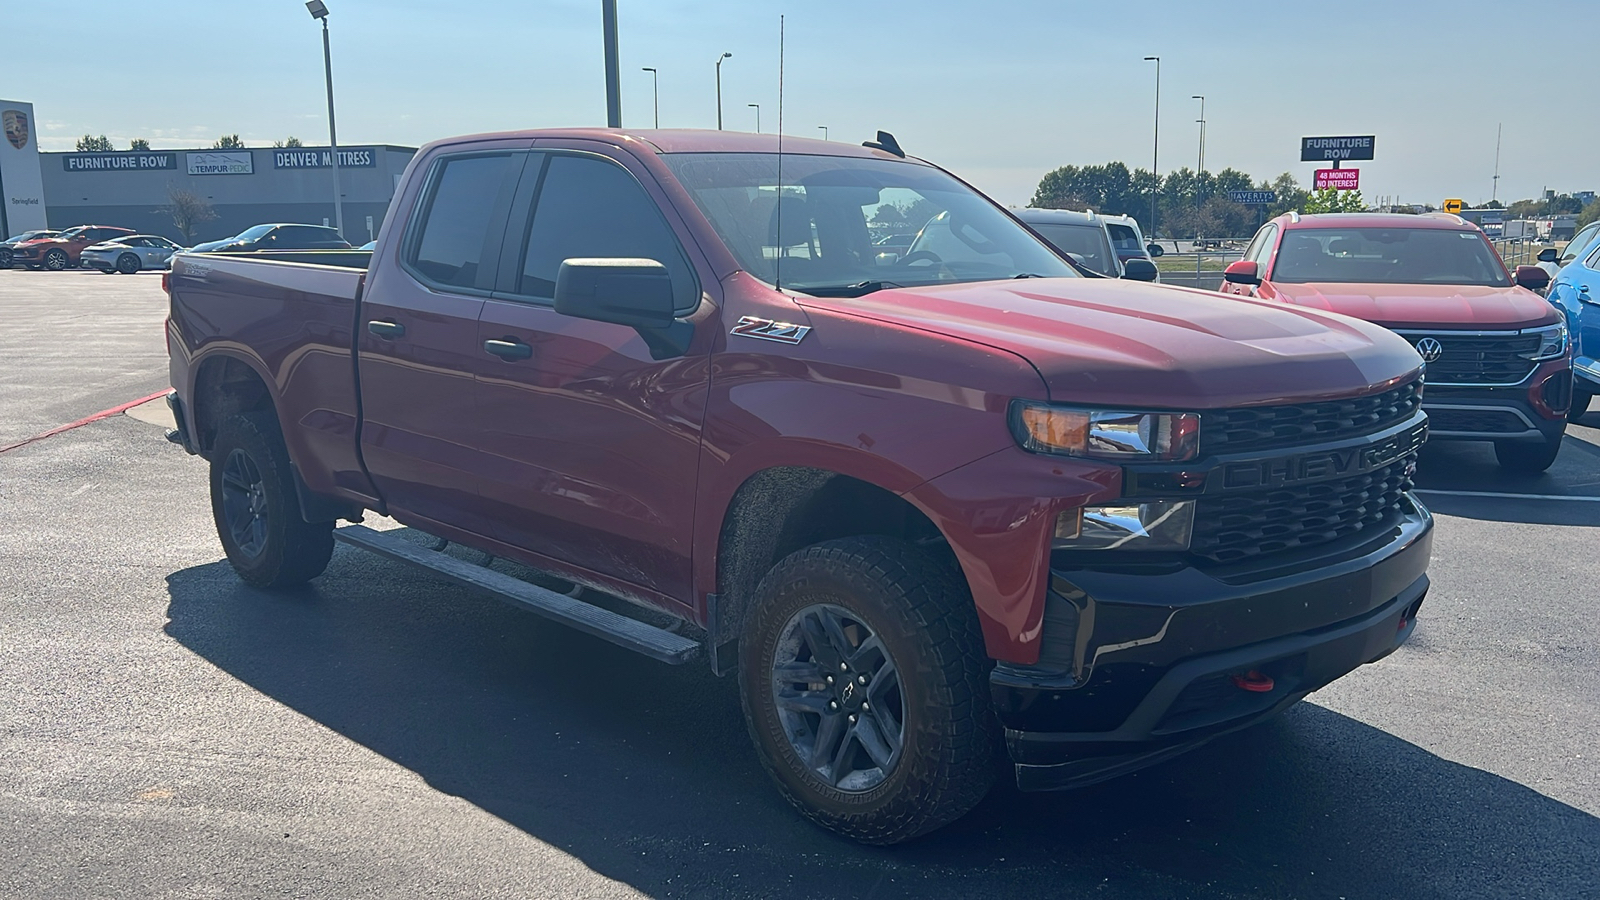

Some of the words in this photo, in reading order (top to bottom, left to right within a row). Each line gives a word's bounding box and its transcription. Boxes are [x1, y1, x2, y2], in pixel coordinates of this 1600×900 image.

[1306, 138, 1370, 149] FURNITURE
[276, 152, 318, 167] DENVER
[322, 151, 371, 166] MTTRESS
[1324, 149, 1351, 159] ROW
[69, 157, 137, 169] FURNITURE
[140, 156, 168, 167] ROW
[1319, 172, 1328, 180] 48
[1328, 171, 1356, 180] MONTHS
[1316, 180, 1326, 188] NO
[1328, 179, 1358, 188] INTEREST
[12, 198, 38, 206] Springfield
[729, 315, 812, 345] Z71
